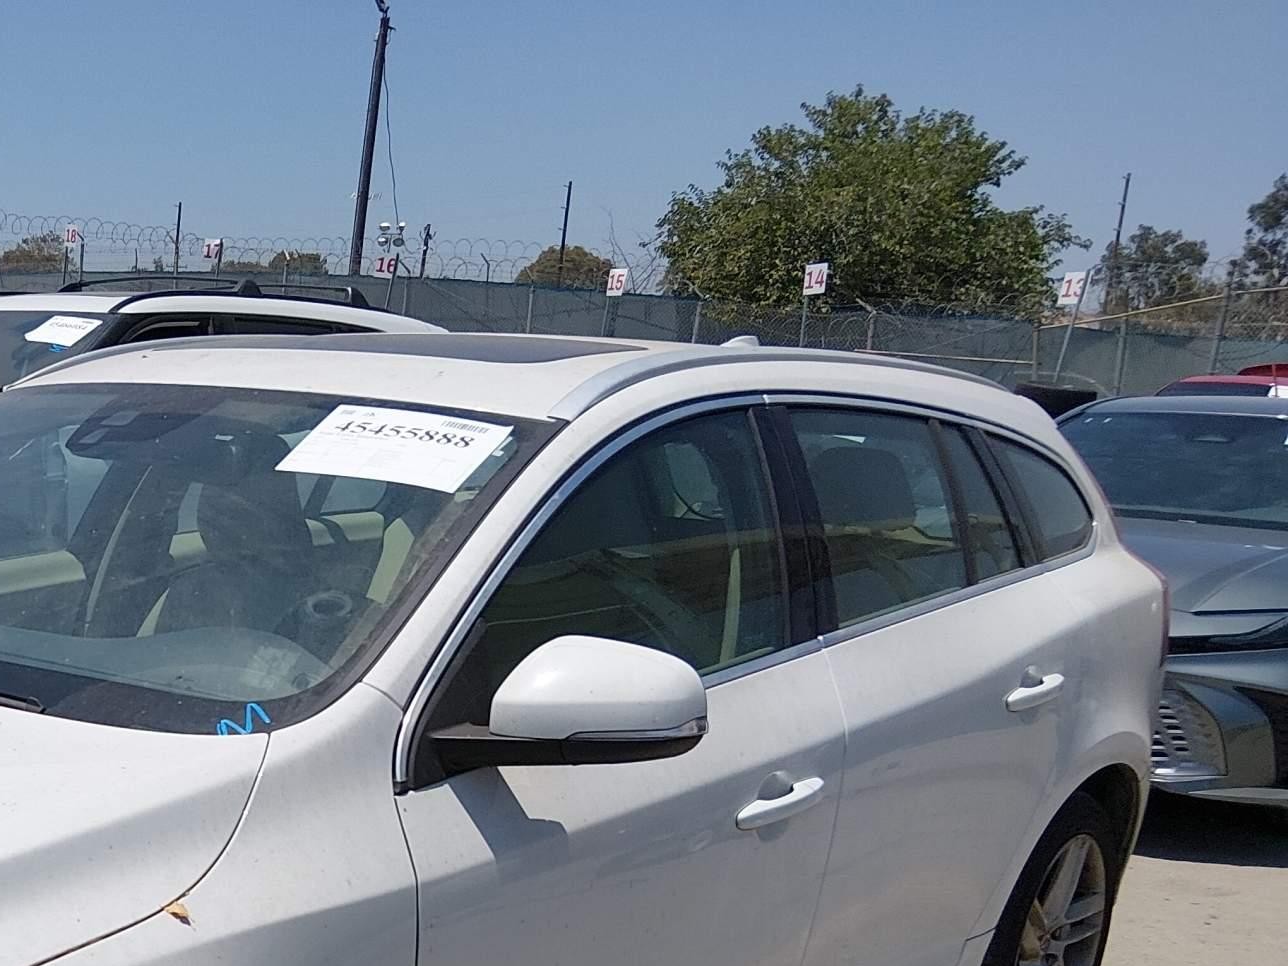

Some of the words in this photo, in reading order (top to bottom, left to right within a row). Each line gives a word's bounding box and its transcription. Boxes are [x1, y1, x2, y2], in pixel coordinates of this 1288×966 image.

[66, 228, 77, 244] 18
[203, 243, 221, 260] 17
[375, 256, 396, 275] 16
[607, 273, 625, 291] 15
[804, 268, 825, 290] 14
[335, 420, 475, 449] 45455888
